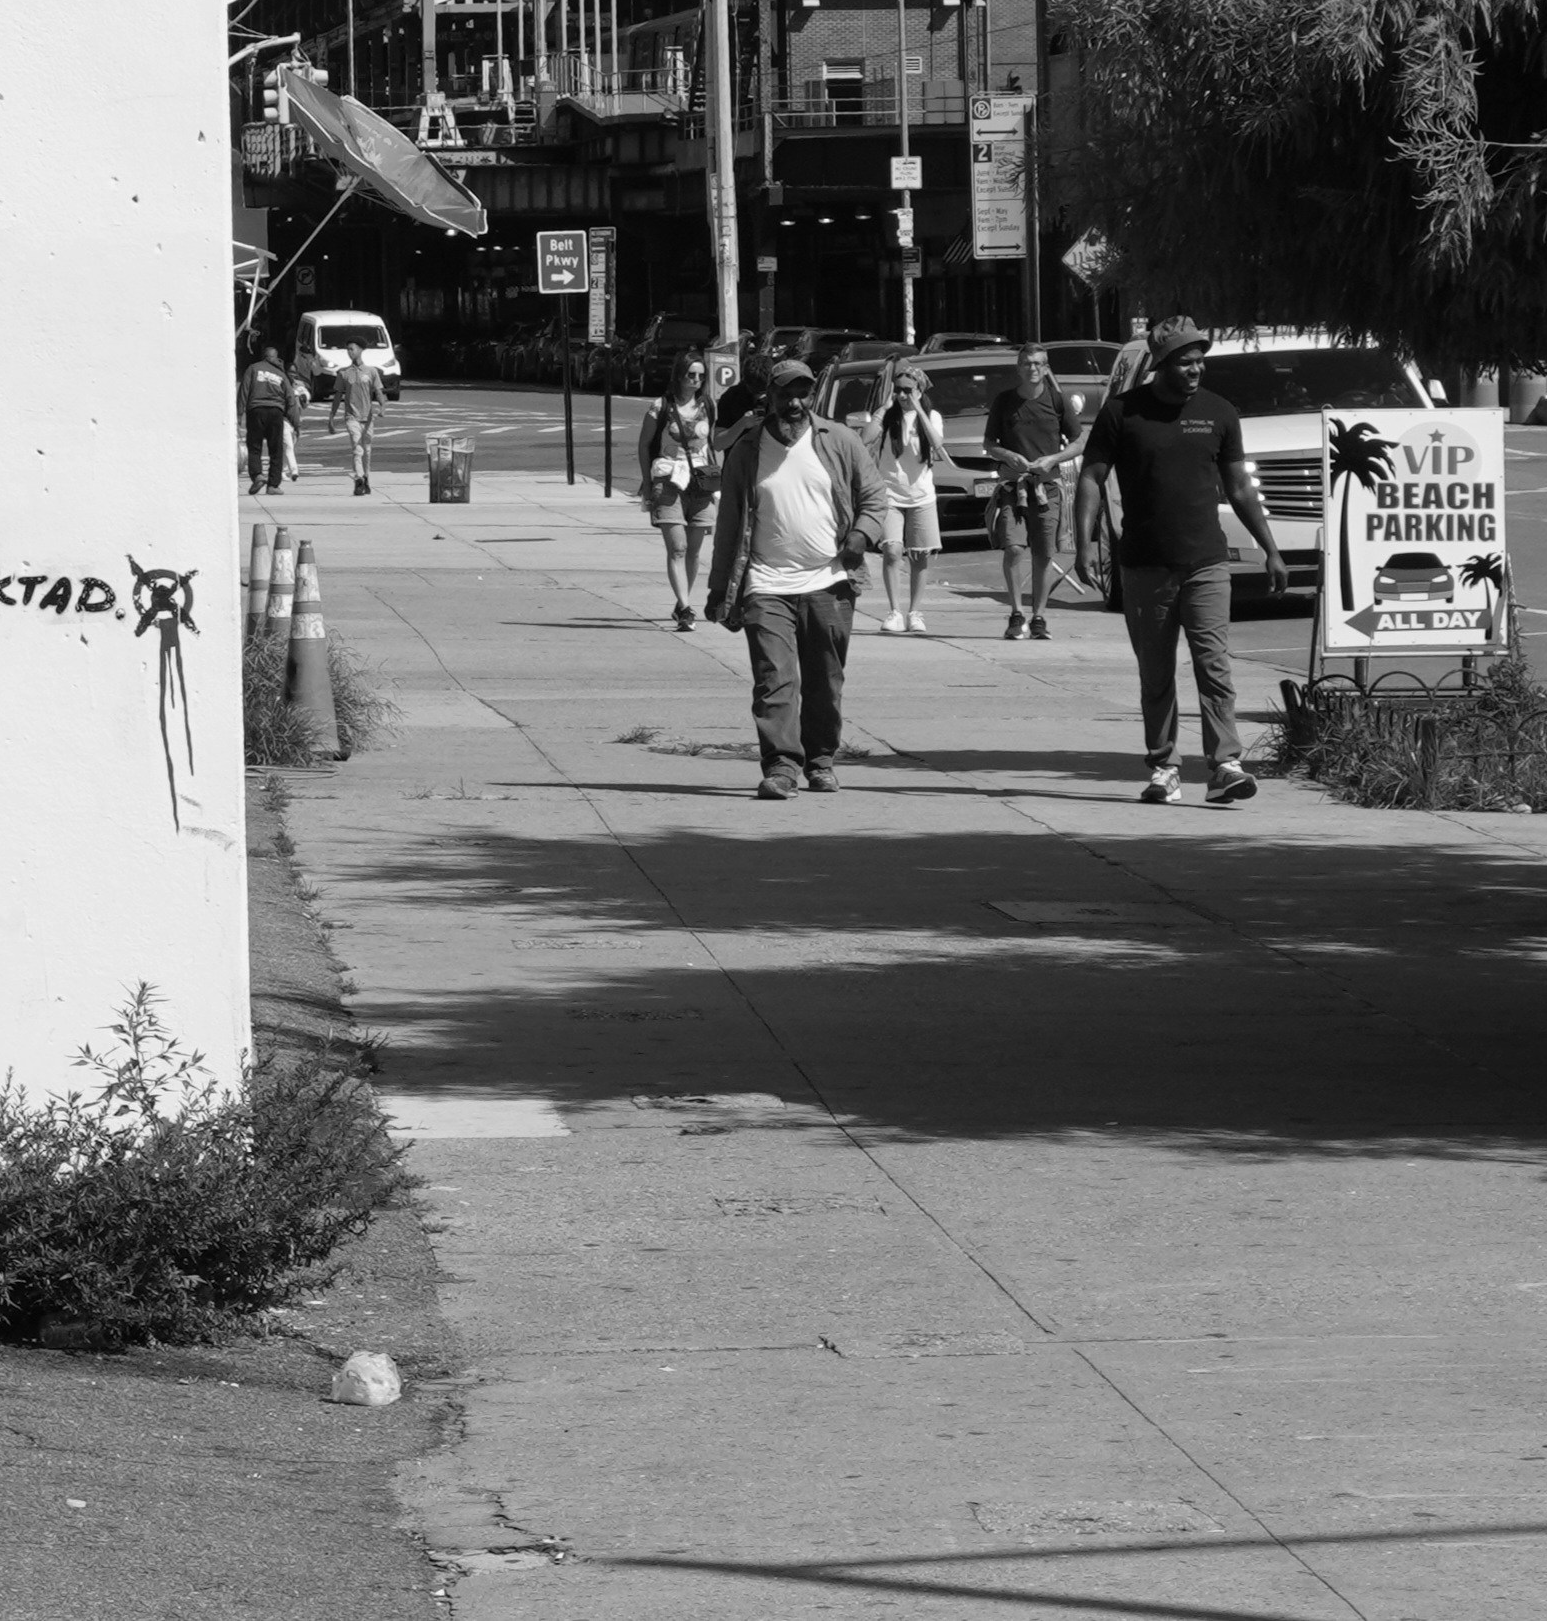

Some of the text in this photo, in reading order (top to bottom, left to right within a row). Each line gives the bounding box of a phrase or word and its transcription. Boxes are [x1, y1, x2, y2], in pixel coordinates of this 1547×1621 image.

[978, 145, 988, 161] 2
[550, 239, 573, 251] Belt
[546, 255, 579, 268] Pkwy
[721, 367, 733, 385] P
[1402, 444, 1475, 475] VIP
[1376, 481, 1495, 510] BEACH
[1365, 513, 1497, 542] PARKING
[1377, 610, 1482, 630] ALL DAY
